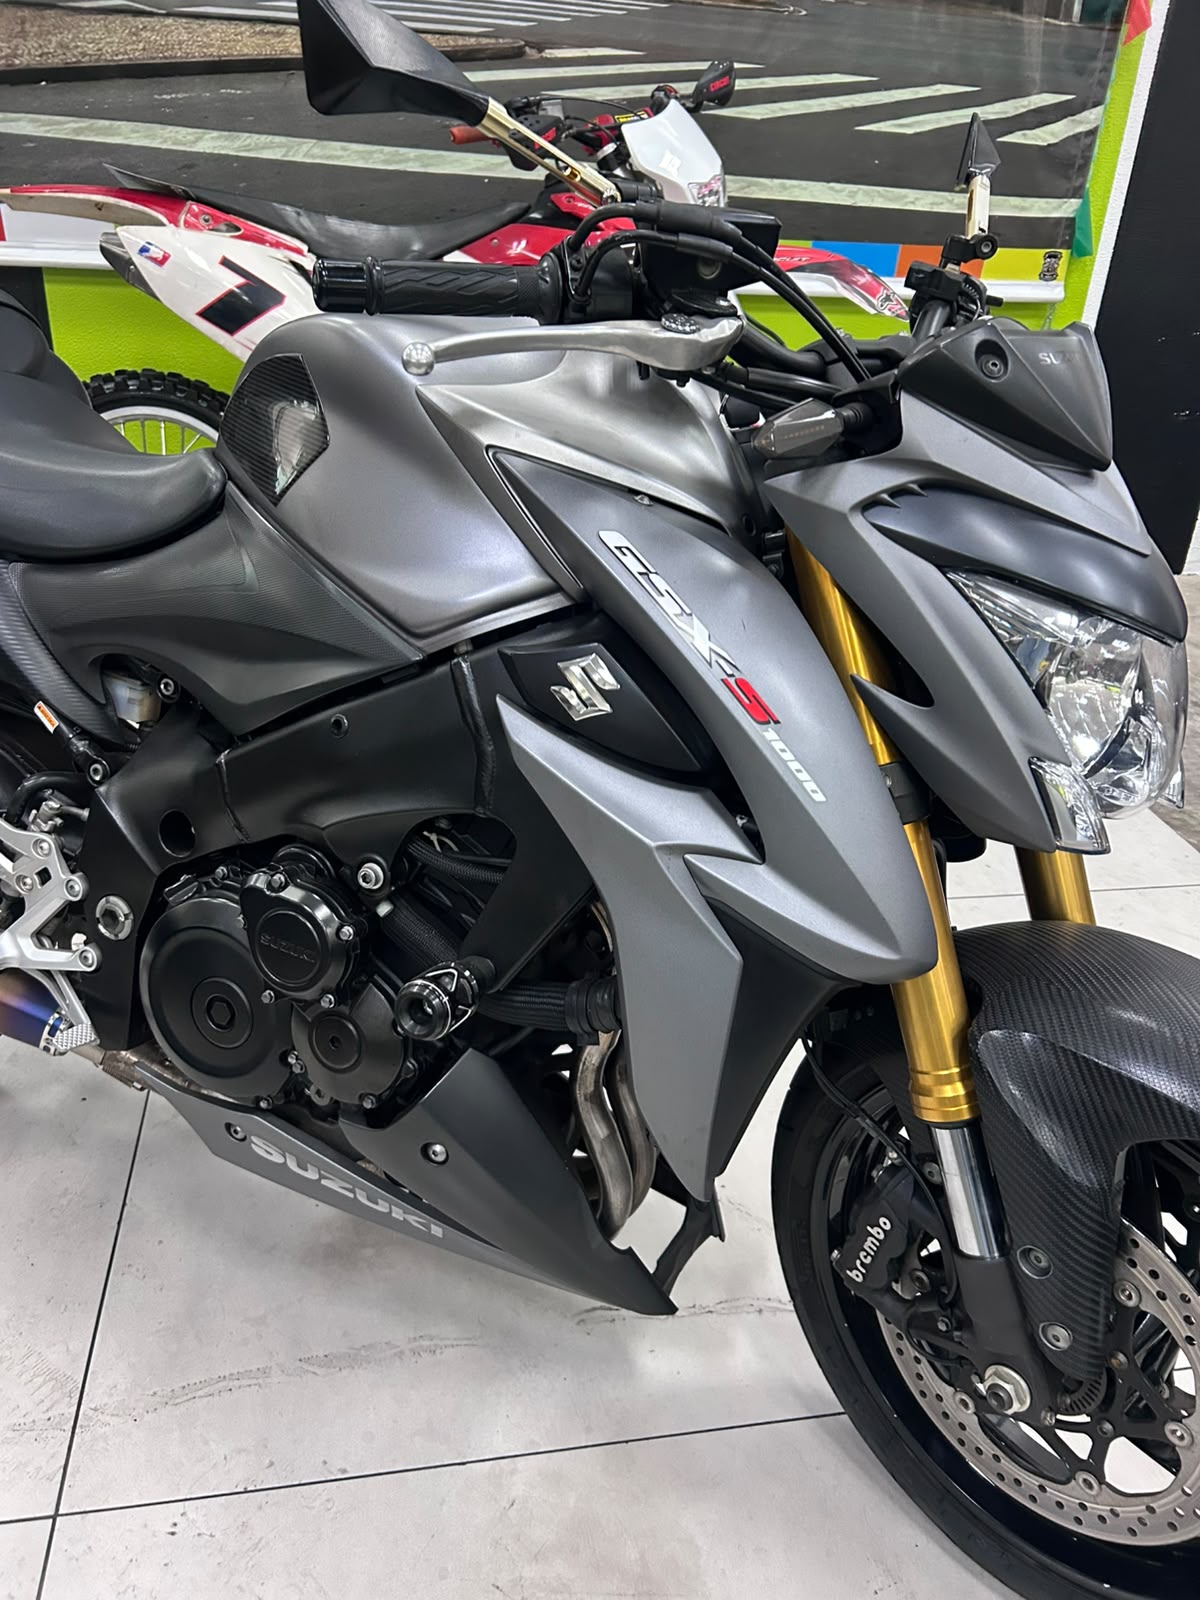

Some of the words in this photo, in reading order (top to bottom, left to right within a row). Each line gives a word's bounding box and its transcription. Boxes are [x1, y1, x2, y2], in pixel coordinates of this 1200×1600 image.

[195, 255, 287, 337] 7
[260, 932, 316, 963] SUZUKI
[250, 1135, 444, 1239] SUZUKI
[845, 1216, 892, 1283] brembo
